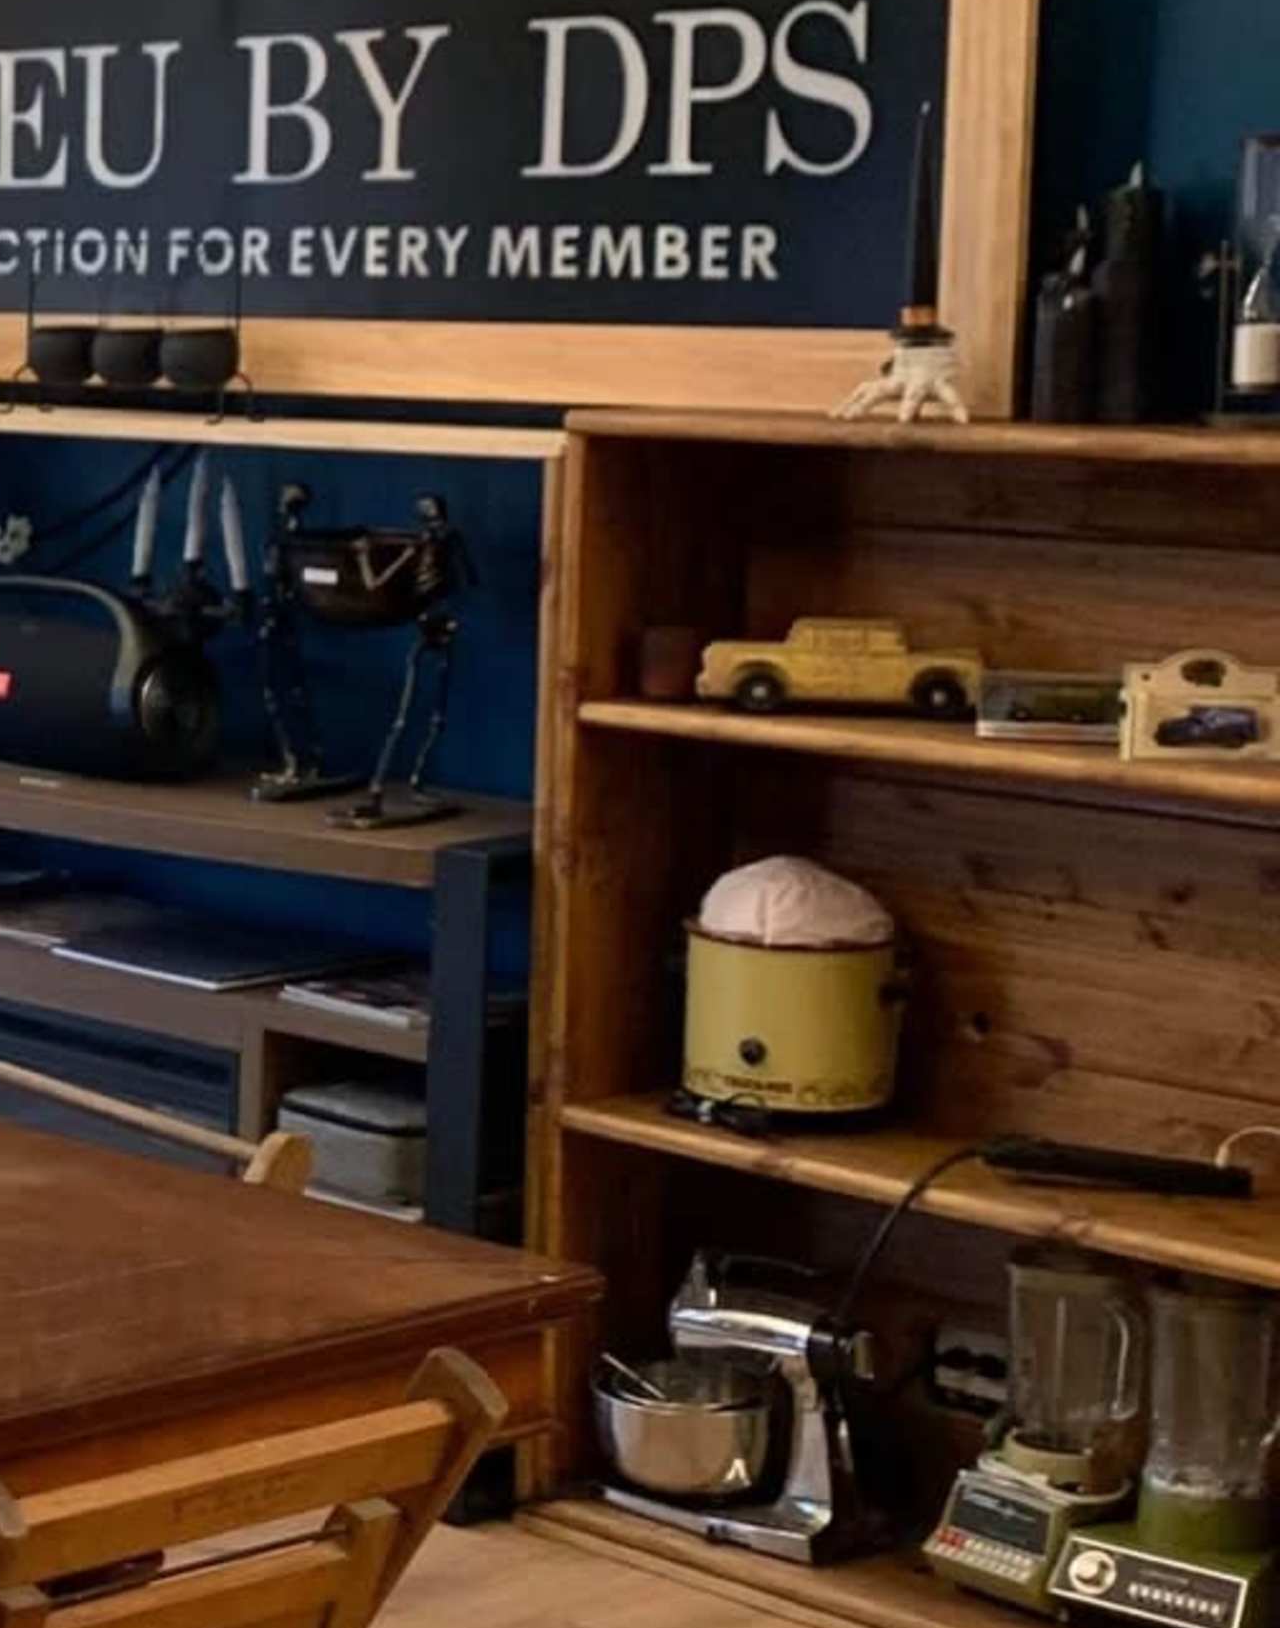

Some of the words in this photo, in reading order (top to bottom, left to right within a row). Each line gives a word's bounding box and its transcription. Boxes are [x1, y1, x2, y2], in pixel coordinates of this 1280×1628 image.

[233, 24, 451, 185] BY
[168, 227, 272, 277] FOR
[289, 225, 470, 278] EVERY
[486, 224, 779, 282] MEMBER
